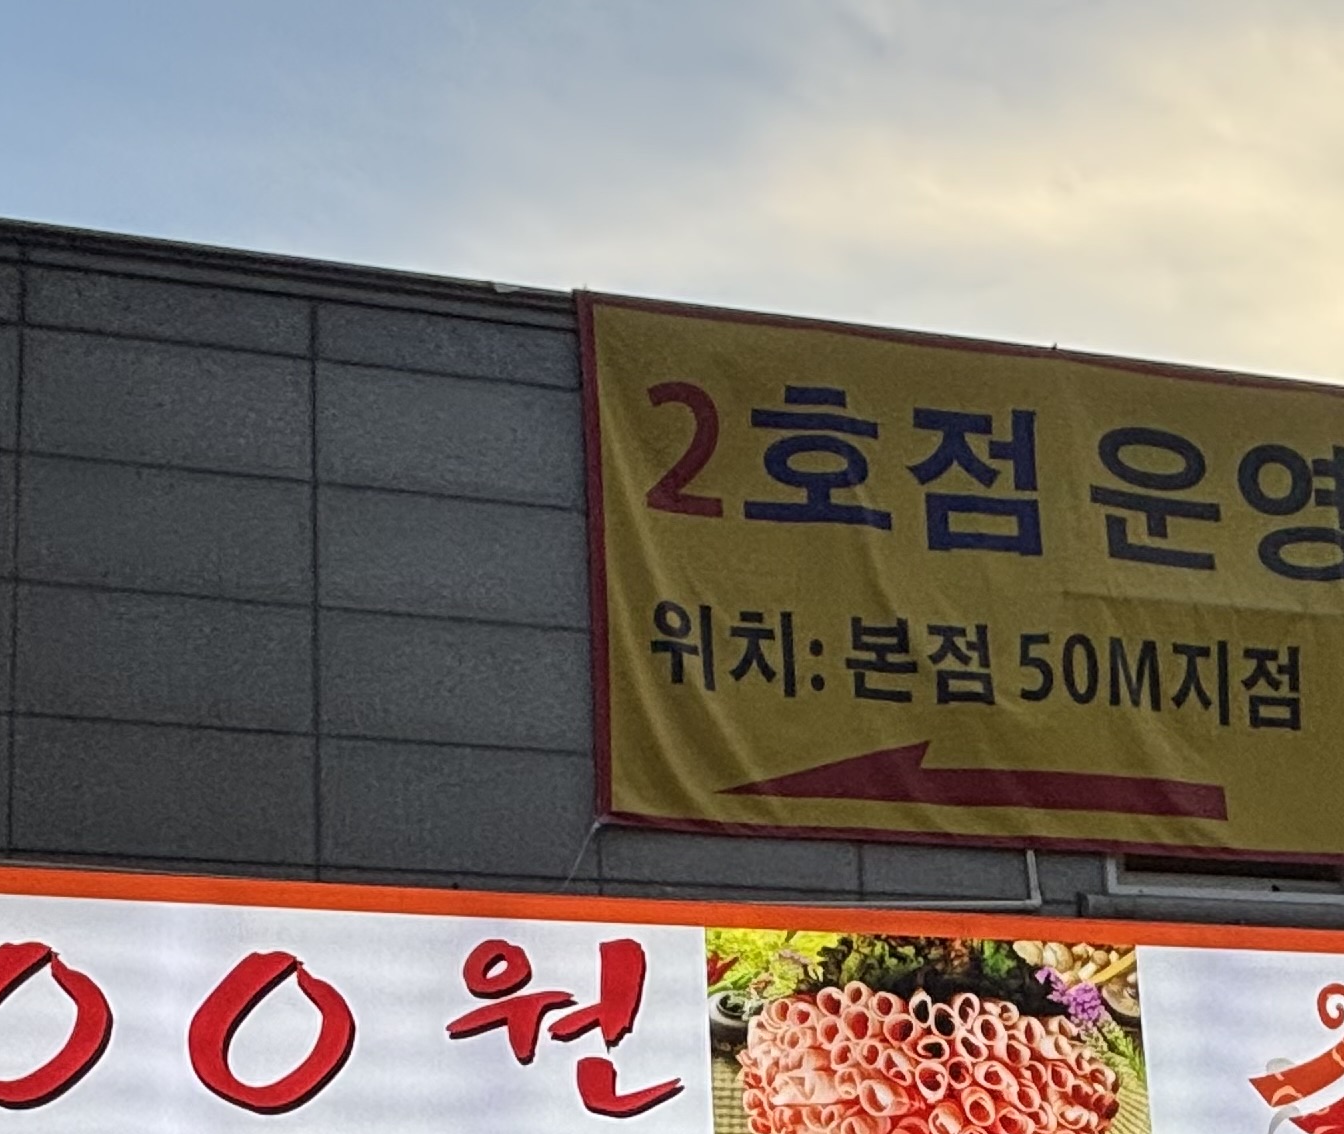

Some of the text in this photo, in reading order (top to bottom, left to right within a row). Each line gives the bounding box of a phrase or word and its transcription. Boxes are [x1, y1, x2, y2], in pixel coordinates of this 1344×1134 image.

[646, 381, 1042, 556] 2호점
[651, 601, 825, 696] 위치:
[846, 616, 994, 705] 본점
